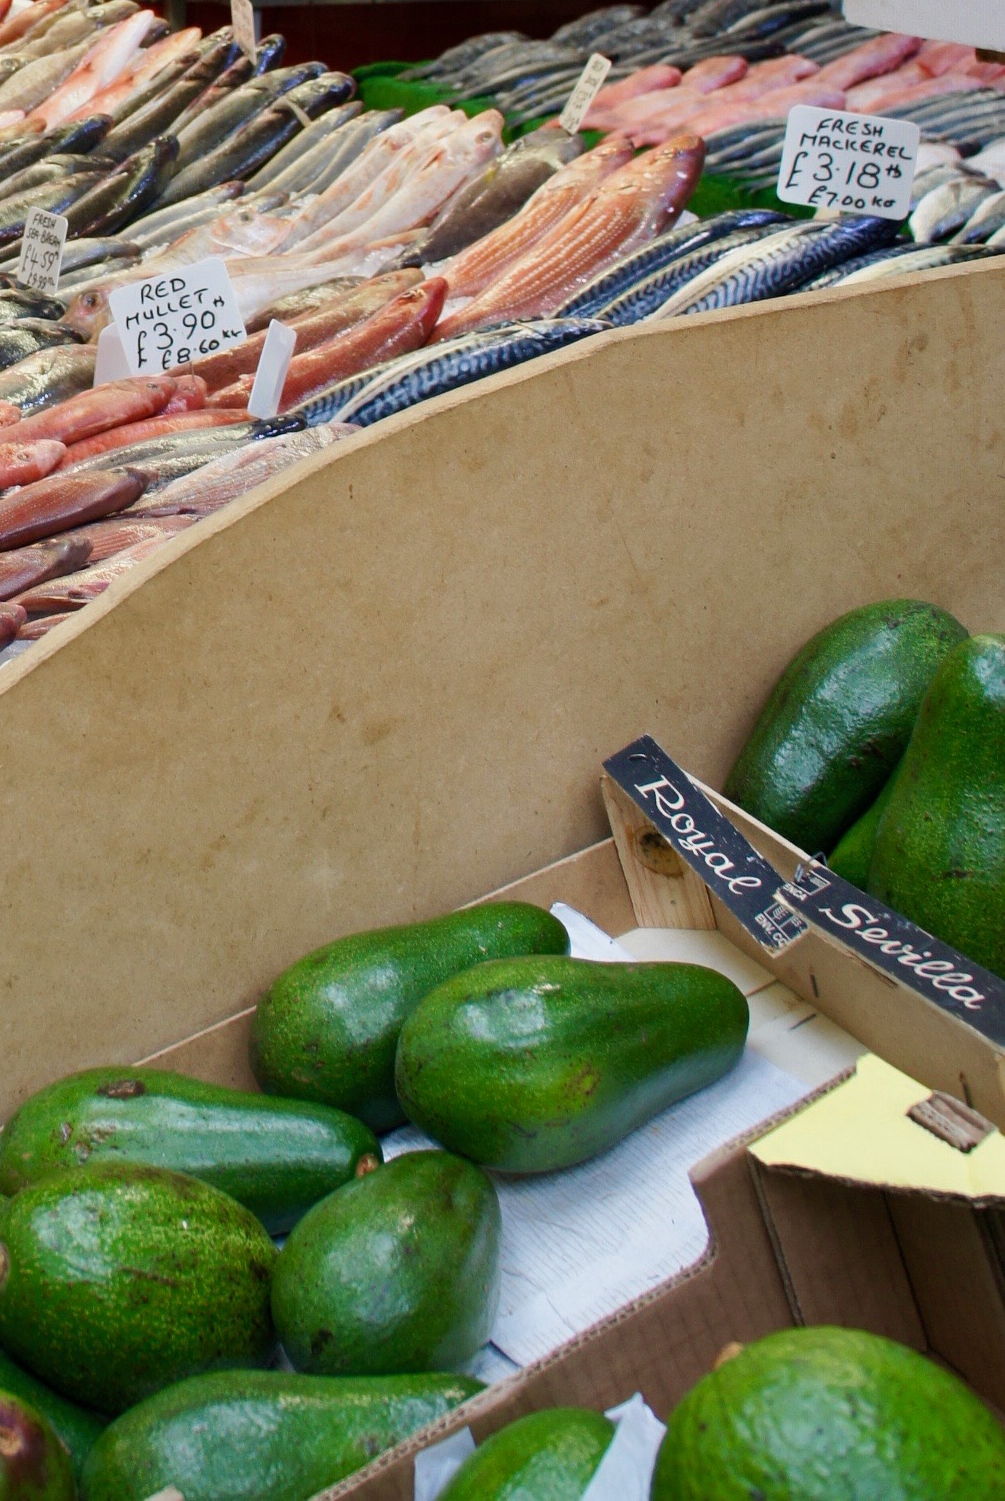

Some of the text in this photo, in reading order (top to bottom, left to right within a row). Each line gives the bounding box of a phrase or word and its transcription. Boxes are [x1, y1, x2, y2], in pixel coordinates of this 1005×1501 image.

[817, 118, 883, 137] FRESH
[799, 133, 912, 160] MACKEREL
[785, 151, 881, 189] £3.18
[808, 185, 865, 209] £7.00
[32, 213, 57, 230] FRESH
[141, 278, 186, 304] RED
[126, 288, 209, 330] MULLET
[137, 310, 215, 368] £3.90
[162, 339, 220, 370] £8.60
[633, 774, 986, 1010] Royal Sevilla
